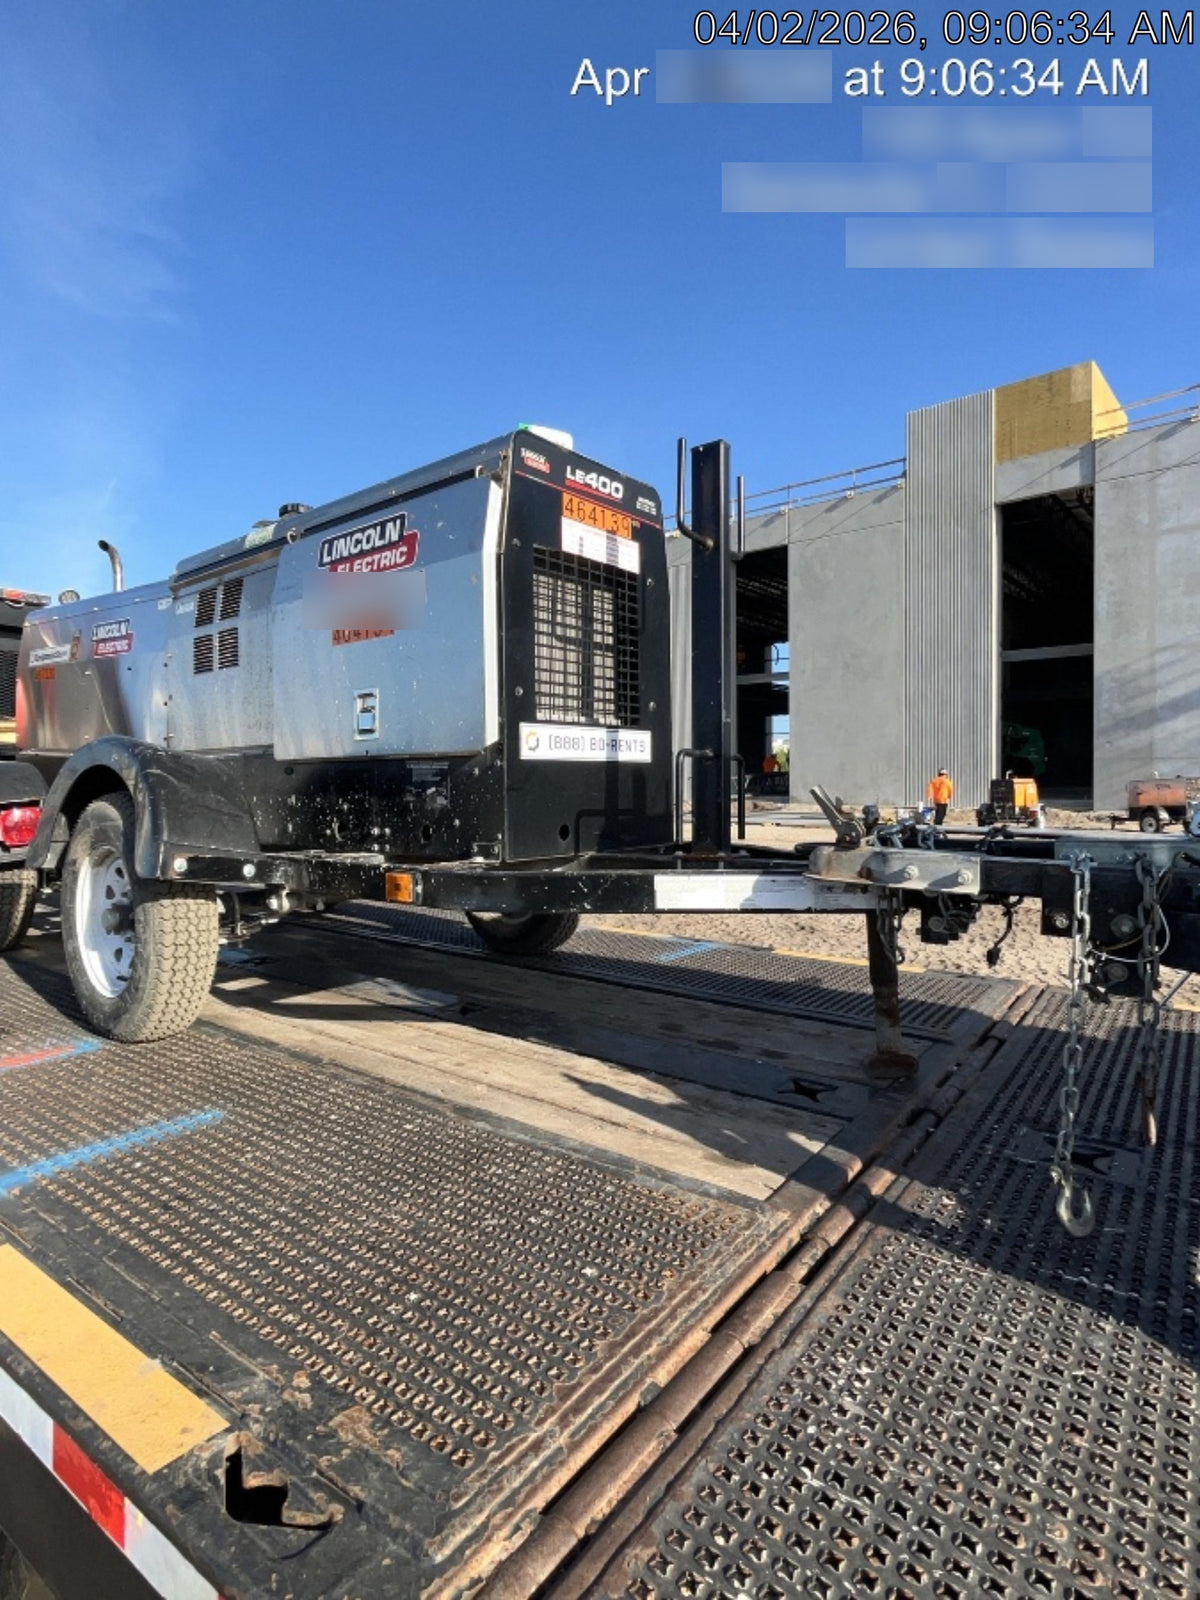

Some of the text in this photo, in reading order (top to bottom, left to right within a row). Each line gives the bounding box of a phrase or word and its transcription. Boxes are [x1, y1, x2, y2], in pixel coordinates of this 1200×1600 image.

[566, 465, 624, 499] LE400
[564, 497, 631, 538] 464139
[322, 518, 401, 564] LINCOLN
